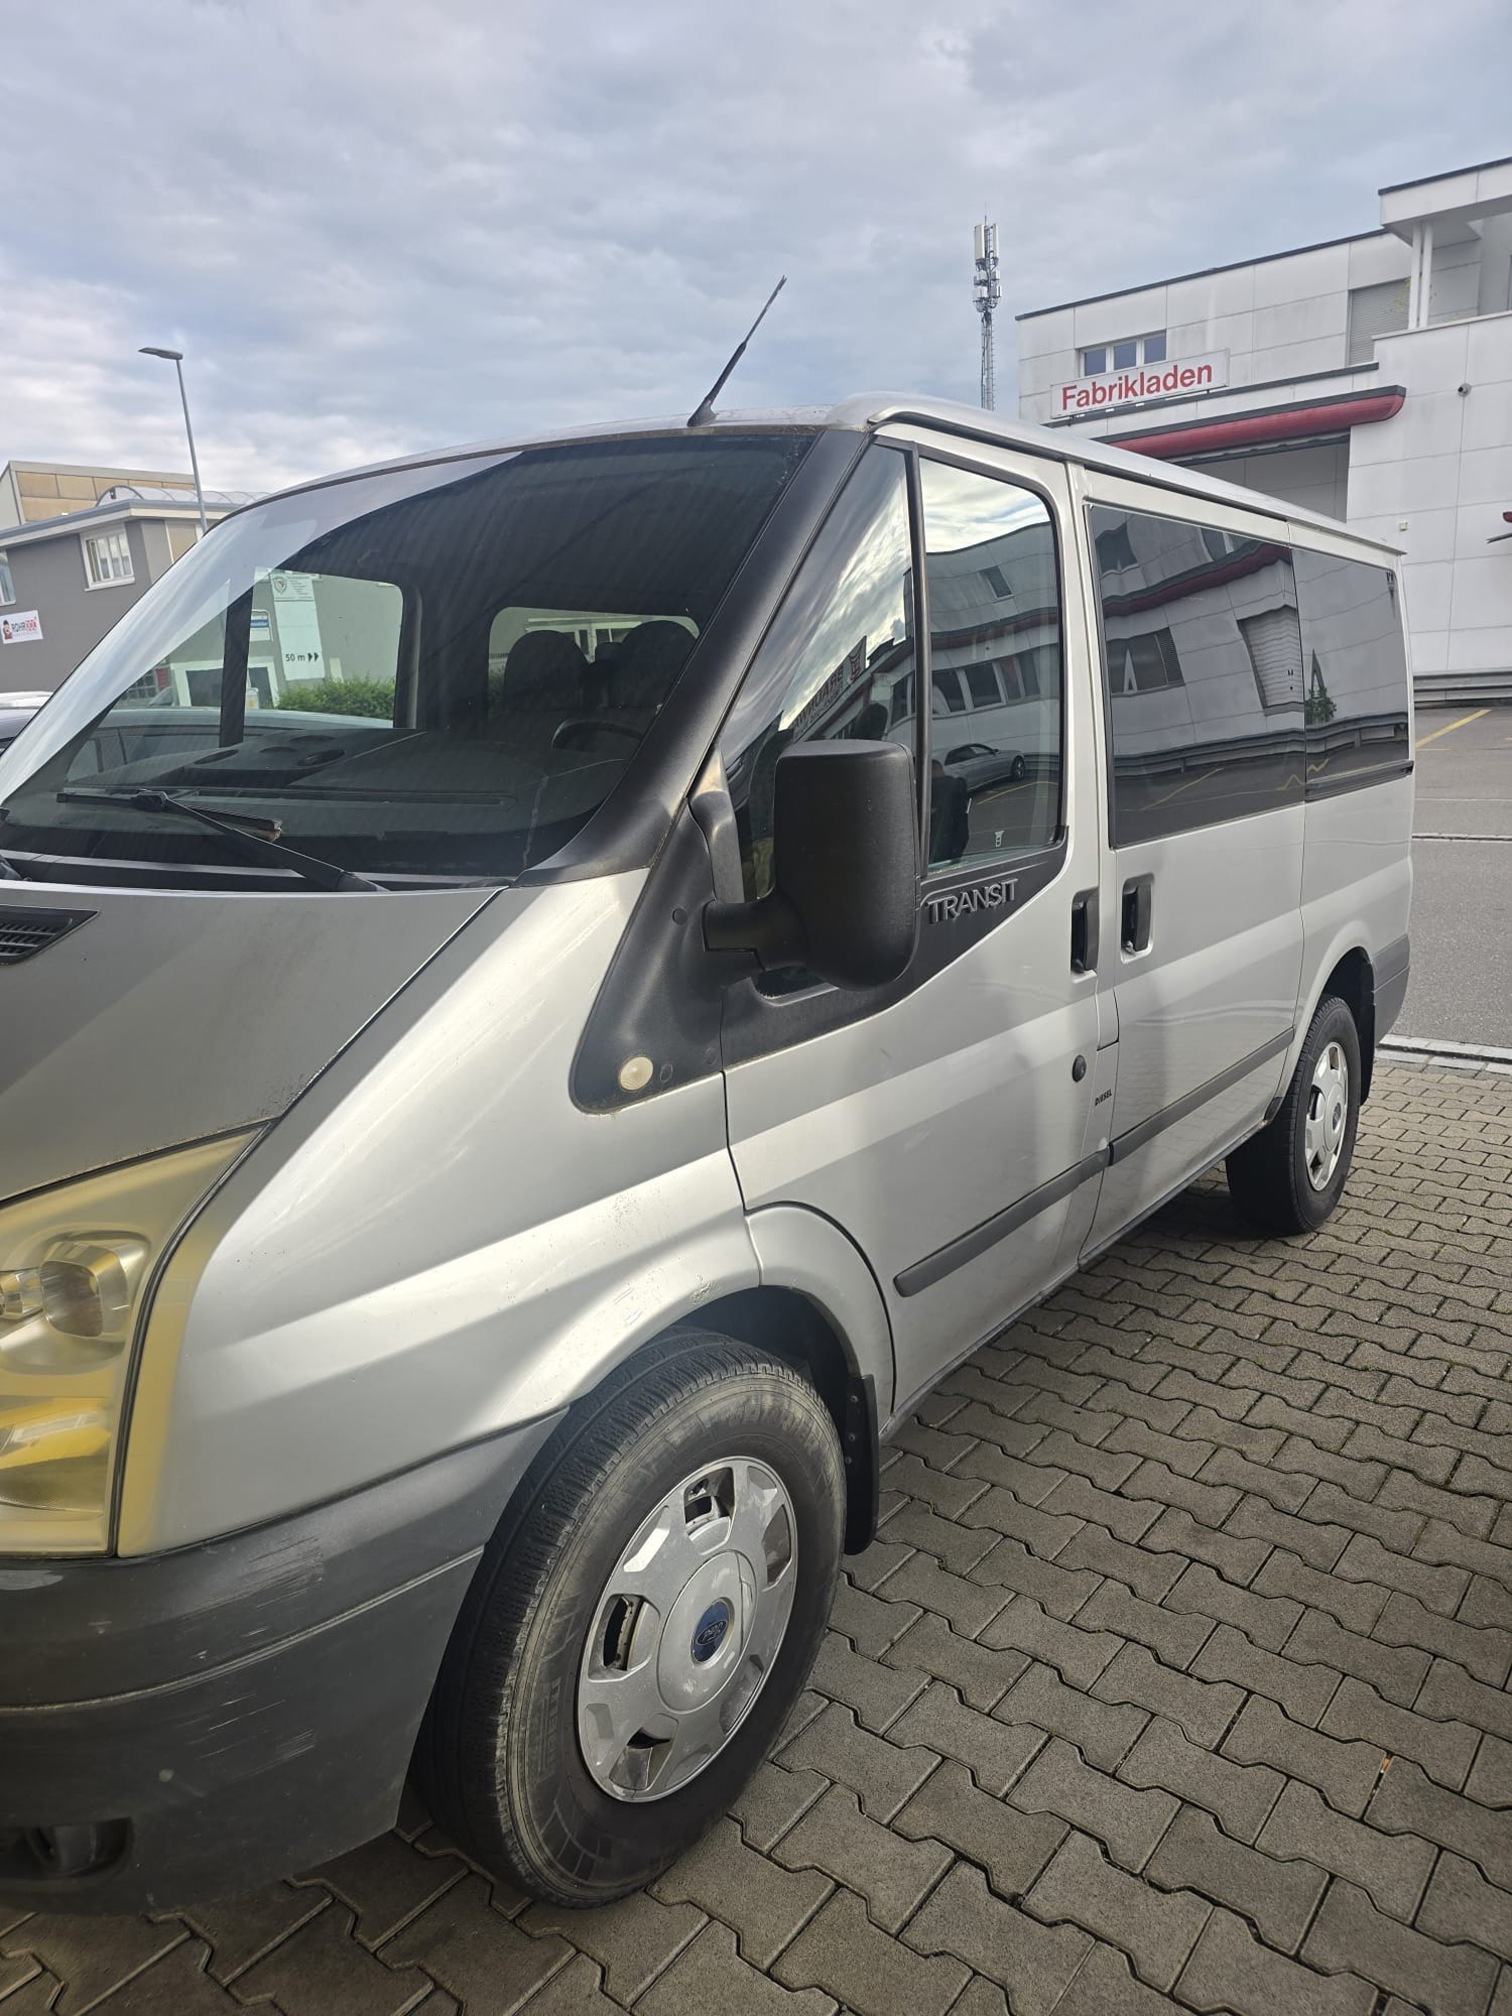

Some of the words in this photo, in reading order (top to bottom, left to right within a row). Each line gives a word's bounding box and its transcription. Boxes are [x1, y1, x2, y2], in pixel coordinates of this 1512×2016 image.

[1061, 364, 1212, 411] Fabrikladen
[285, 653, 296, 662] 50
[927, 879, 1018, 924] TRANSIT
[1095, 1089, 1112, 1106] DIESEL
